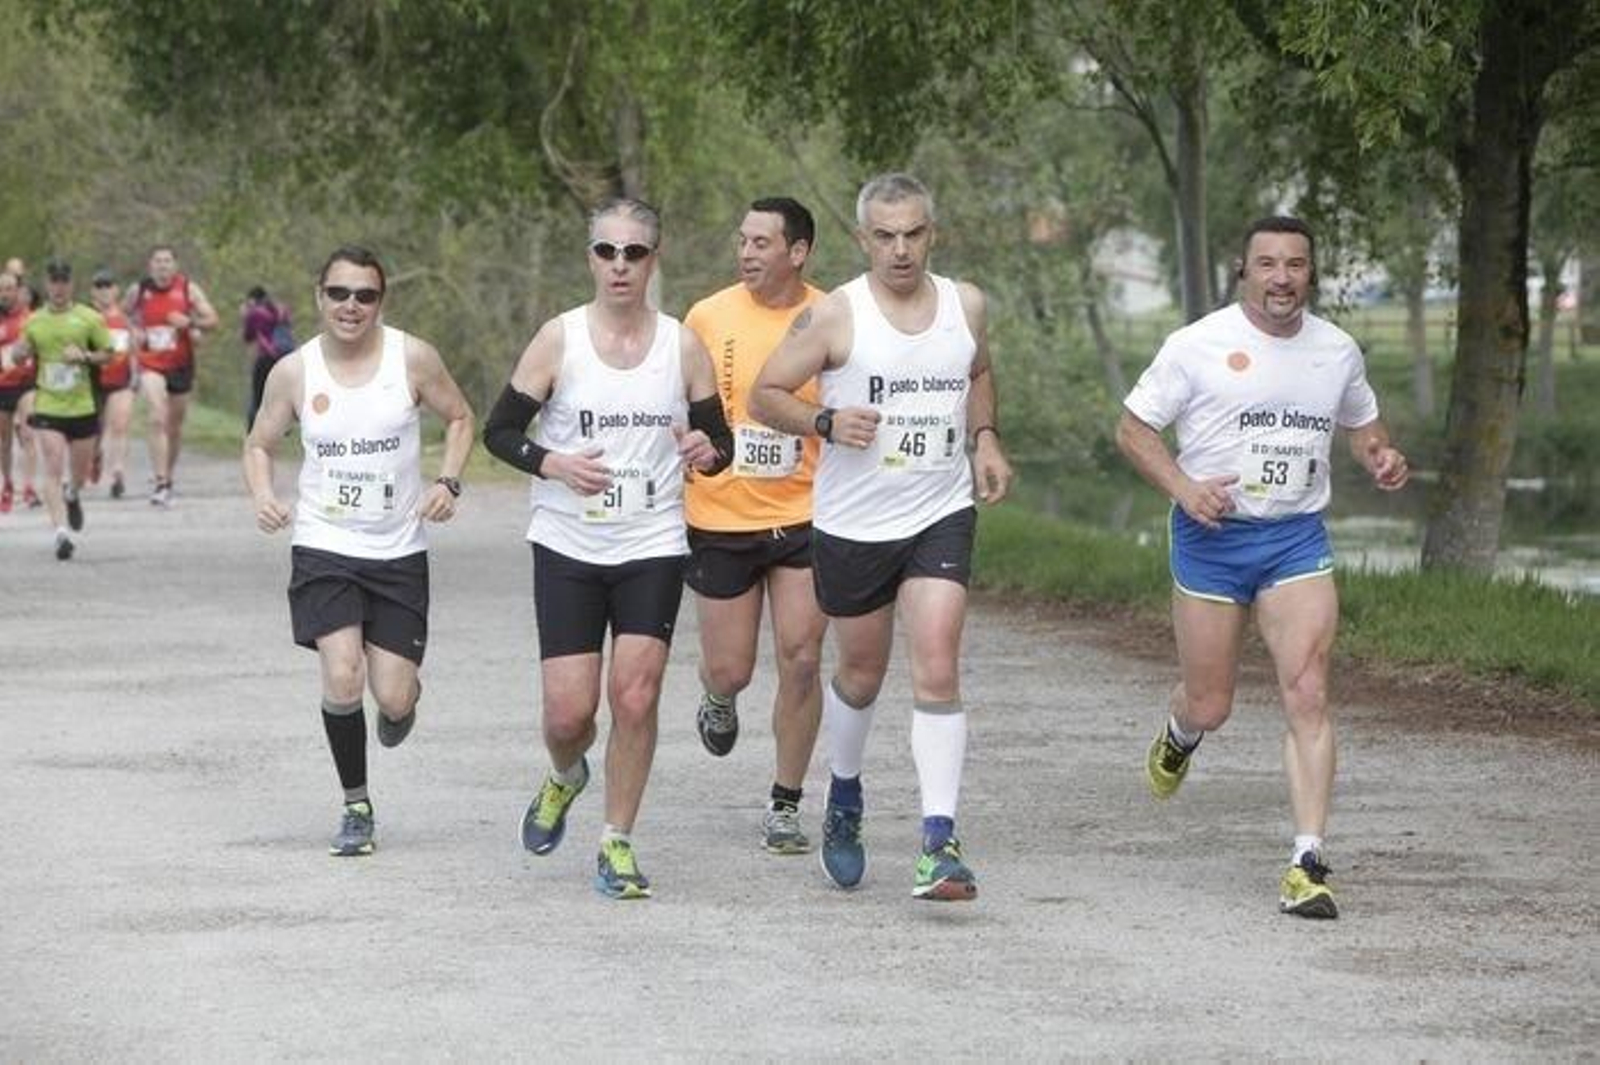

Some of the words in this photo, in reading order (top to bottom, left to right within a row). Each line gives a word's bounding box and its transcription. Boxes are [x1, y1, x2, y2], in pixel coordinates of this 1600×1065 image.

[889, 378, 919, 398] pato
[922, 376, 965, 393] blanco
[599, 413, 629, 431] pato
[632, 412, 673, 427] blanco
[1239, 410, 1277, 432] pato
[1281, 408, 1331, 432] blanco
[317, 440, 347, 458] pato
[351, 436, 400, 455] blanco
[744, 442, 782, 466] 366
[898, 432, 926, 457] 46
[1261, 460, 1289, 485] 53
[339, 485, 362, 507] 52
[603, 485, 623, 507] 51
